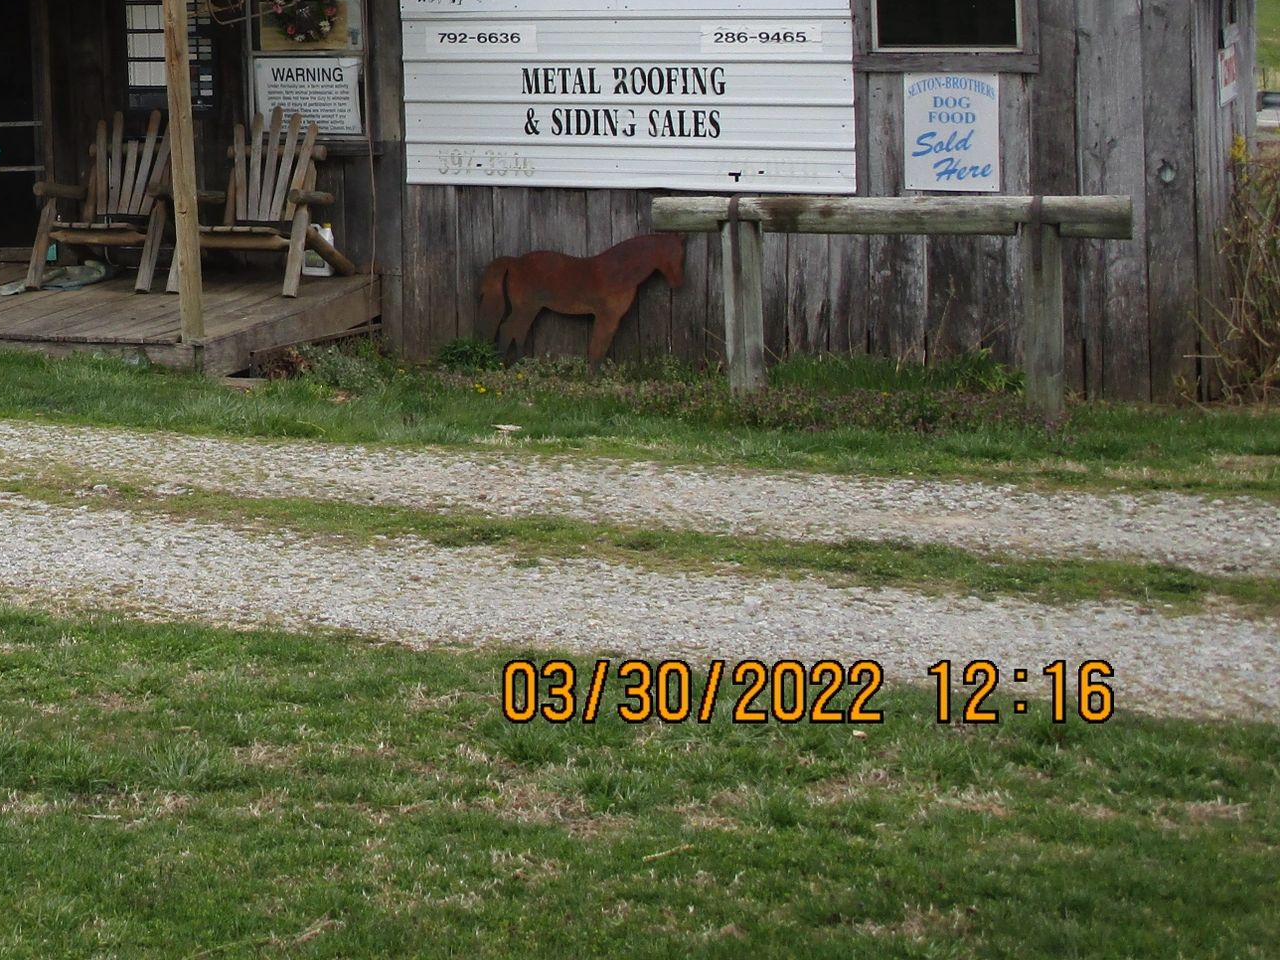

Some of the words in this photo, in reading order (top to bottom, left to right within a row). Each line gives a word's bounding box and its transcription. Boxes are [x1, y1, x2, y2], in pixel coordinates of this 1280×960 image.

[438, 33, 520, 43] 792-6636
[713, 31, 807, 43] 286-9465
[271, 67, 344, 82] WARNING
[521, 67, 601, 95] METAL
[612, 66, 727, 95] ROOFING
[933, 96, 970, 108] DOG
[524, 107, 540, 135] &
[648, 109, 721, 138] SALES
[928, 111, 976, 124] FOOD
[911, 129, 974, 157] Sold
[933, 157, 993, 182] Here
